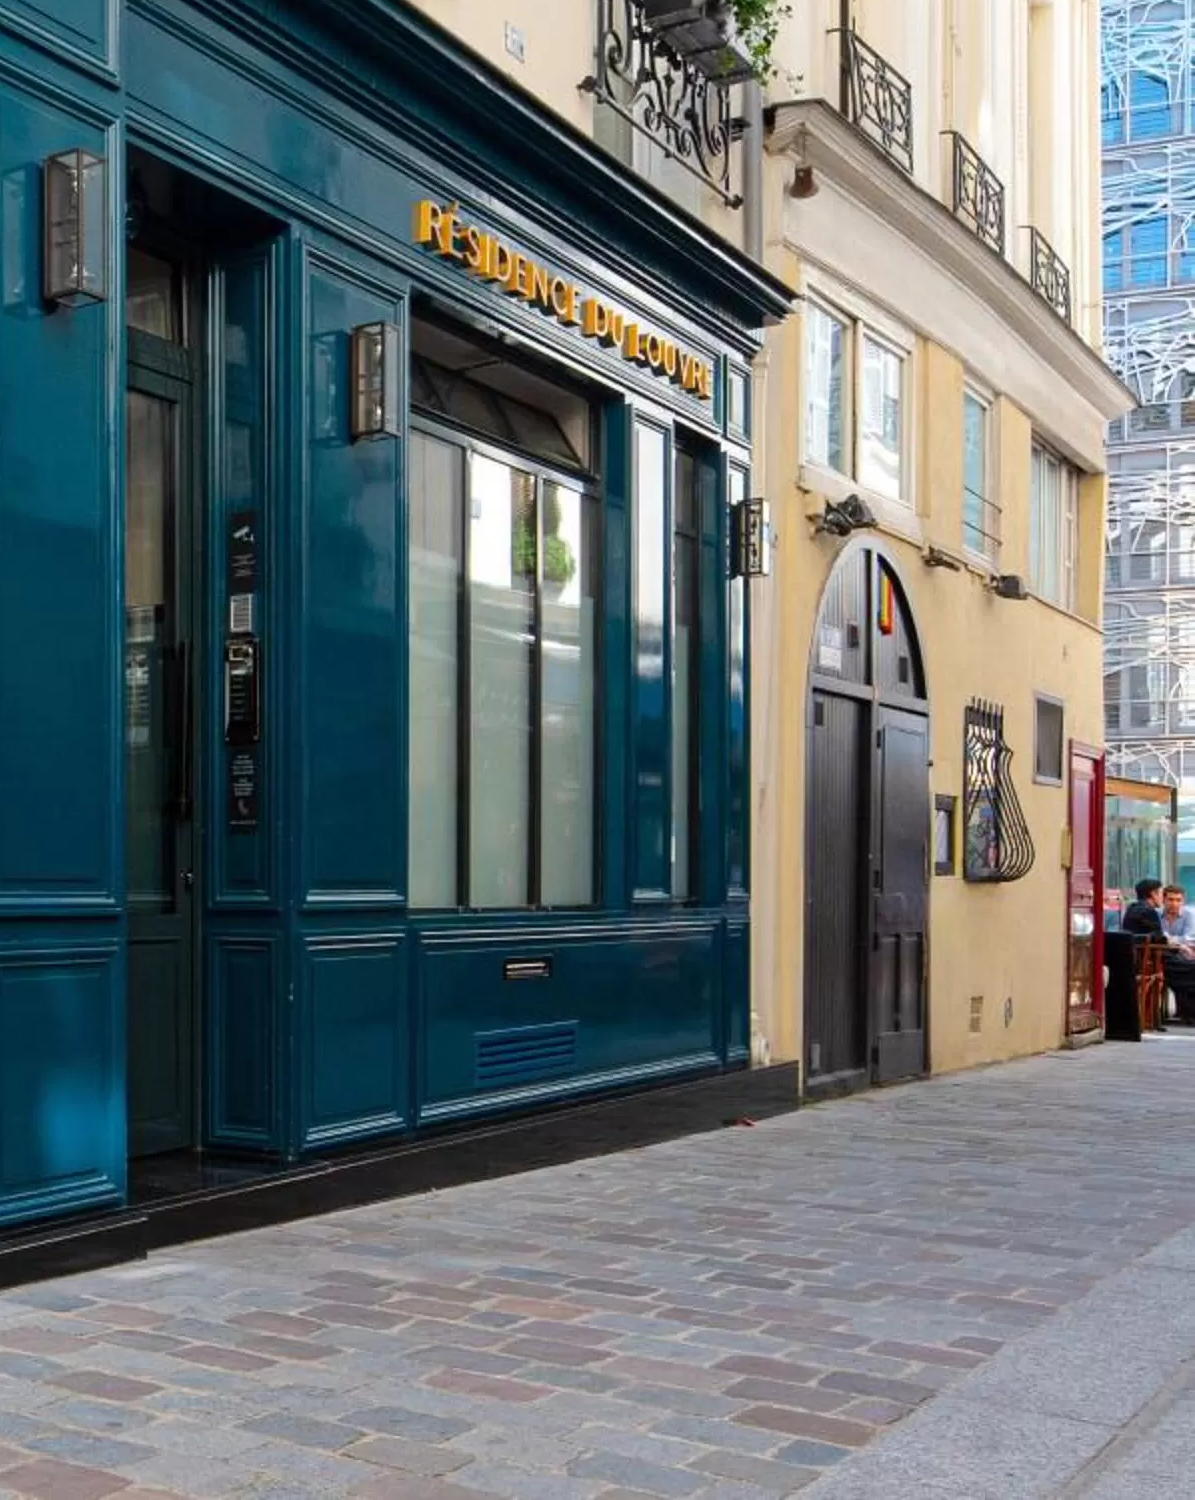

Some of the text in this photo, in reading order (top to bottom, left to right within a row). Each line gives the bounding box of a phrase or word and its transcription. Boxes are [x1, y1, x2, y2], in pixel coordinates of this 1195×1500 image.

[412, 199, 711, 398] RÉSIDENCE DU LOUVRE
